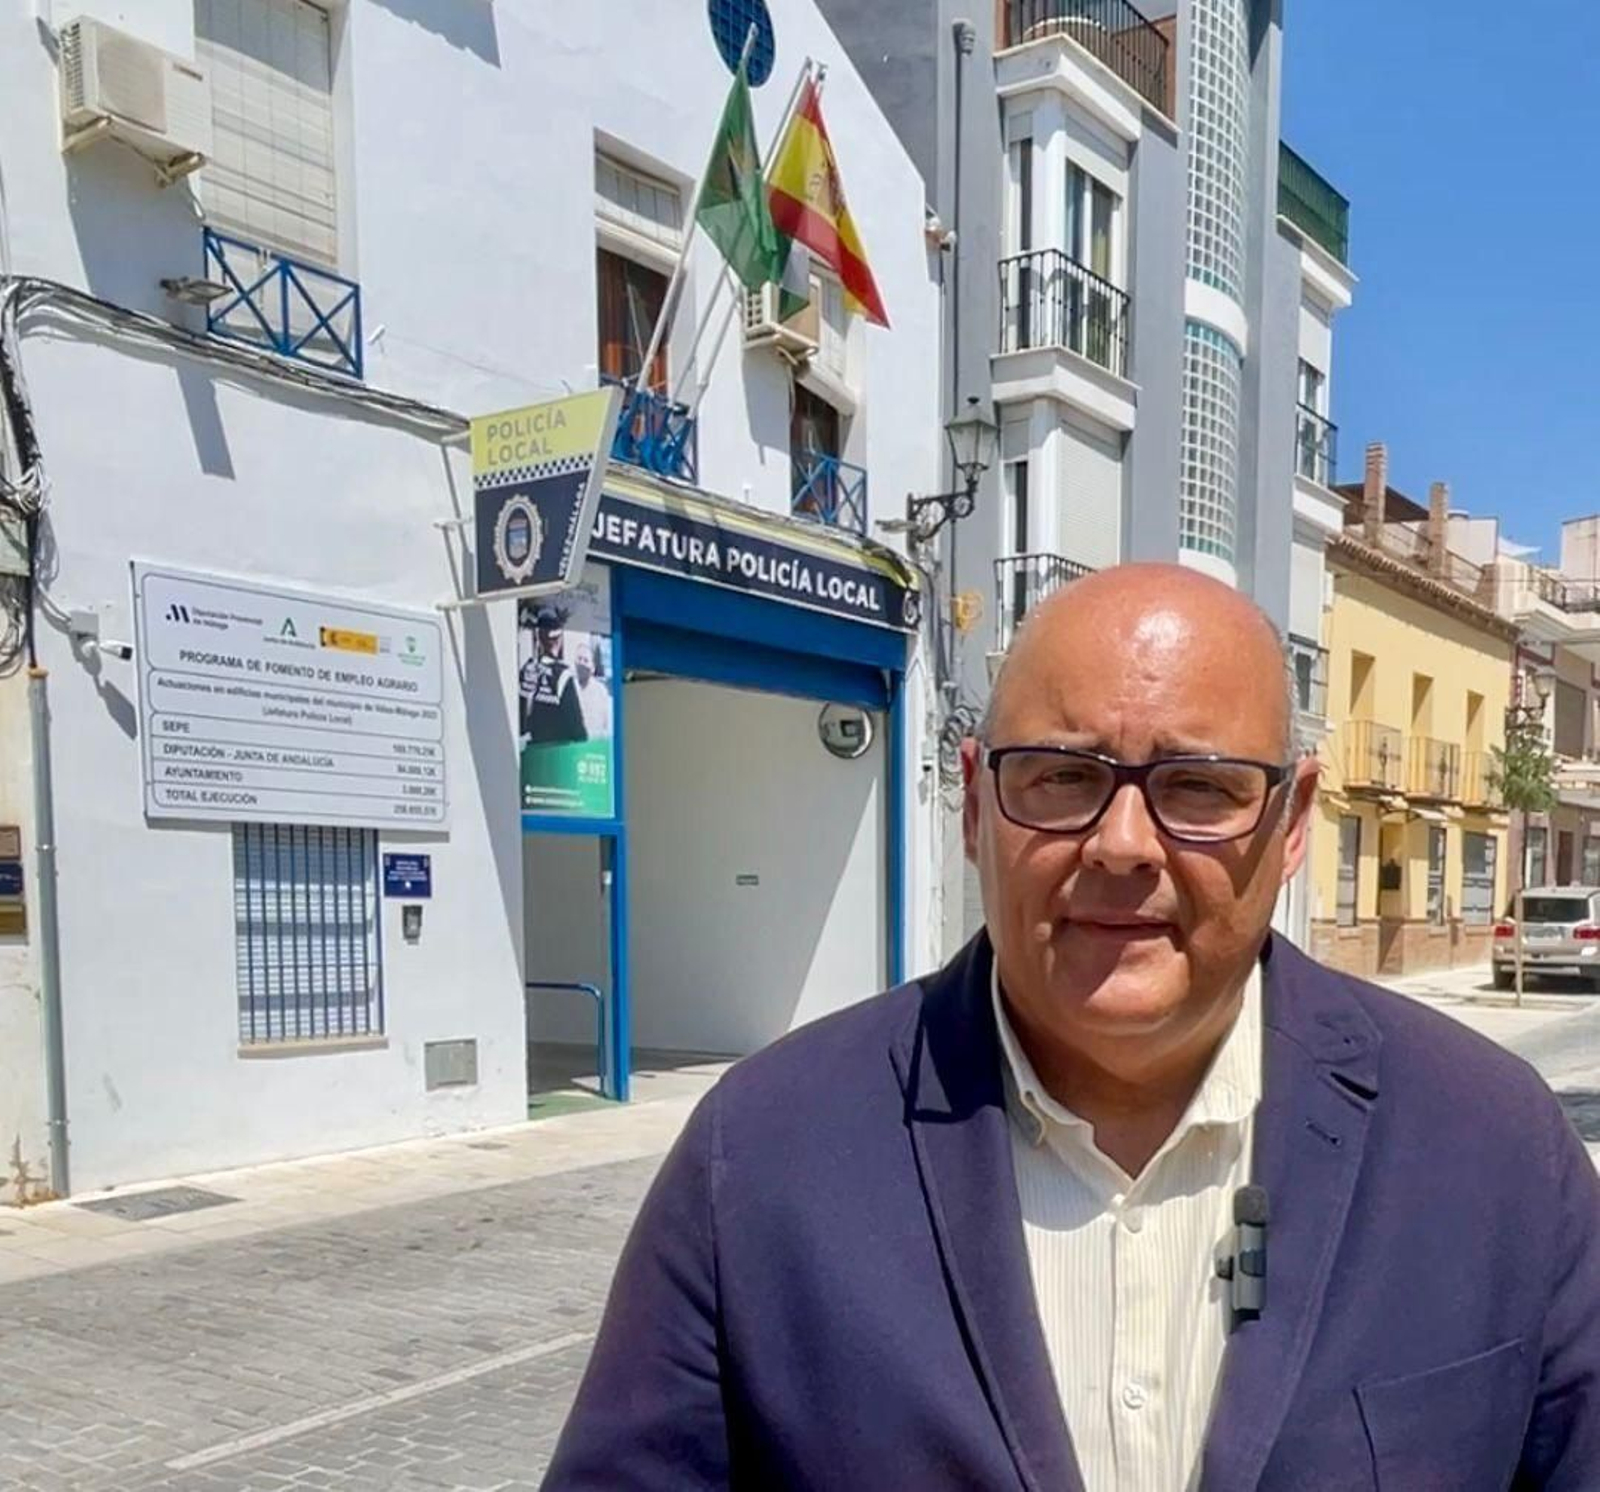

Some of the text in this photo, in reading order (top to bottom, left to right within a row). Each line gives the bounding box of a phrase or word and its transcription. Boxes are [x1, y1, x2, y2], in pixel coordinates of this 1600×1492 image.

[486, 408, 567, 442] POLICÍA
[487, 438, 553, 466] LOCAL
[591, 512, 881, 611] JEFATURA POLICÍA LOCAL
[180, 650, 418, 692] PROGRAMA DE FOMENTO DE EMPLEO AGRARIO
[157, 677, 212, 693] Actuaciones
[163, 721, 190, 734] SEPE
[163, 742, 225, 759] DIPUTACIÓN
[234, 748, 265, 761] JUNTA
[266, 752, 279, 762] DE
[282, 753, 334, 768] ANDALUCÍA
[165, 766, 243, 782] AYUNTAMIENTO
[166, 788, 257, 805] TOTAL EJECUCIÓN
